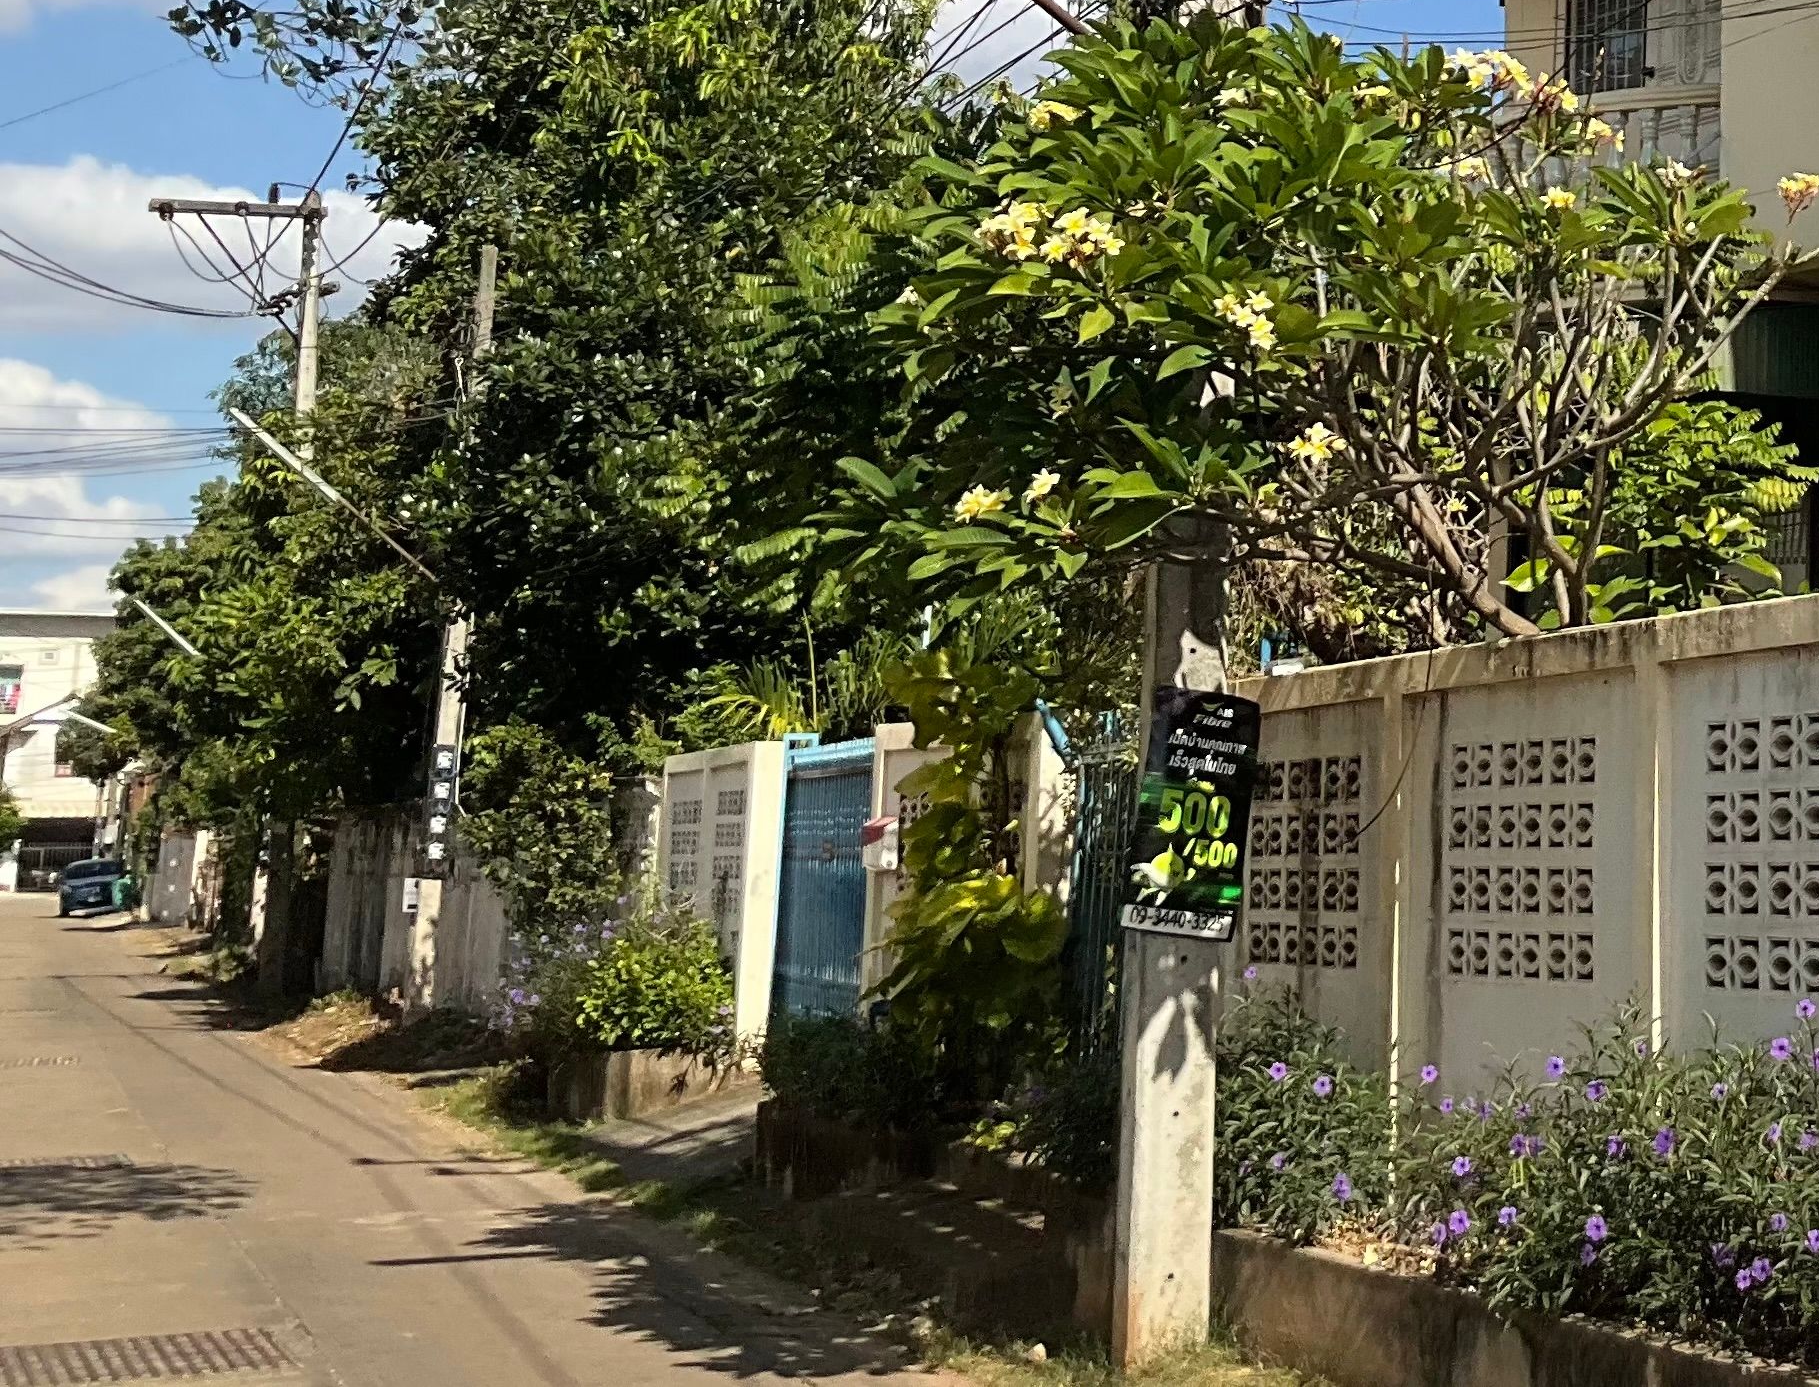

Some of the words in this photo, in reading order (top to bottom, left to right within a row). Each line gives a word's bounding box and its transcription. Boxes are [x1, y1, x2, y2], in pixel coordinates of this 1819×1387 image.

[1192, 713, 1233, 728] Fibre
[1216, 708, 1234, 718] AIS
[1159, 788, 1231, 839] 500
